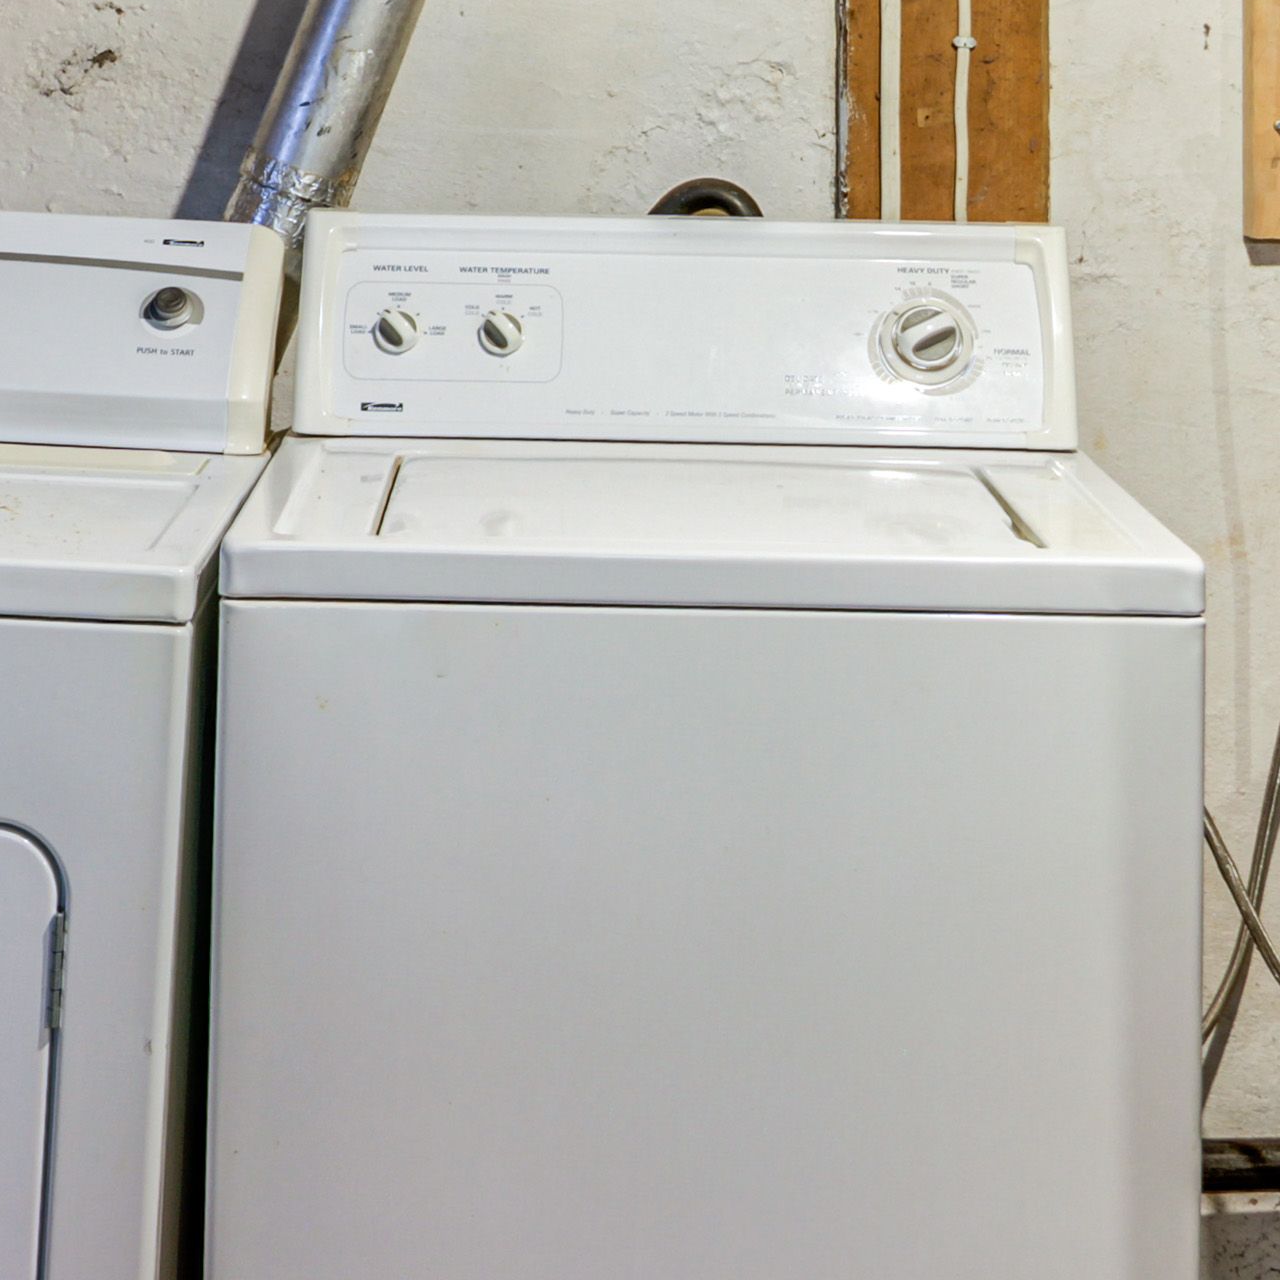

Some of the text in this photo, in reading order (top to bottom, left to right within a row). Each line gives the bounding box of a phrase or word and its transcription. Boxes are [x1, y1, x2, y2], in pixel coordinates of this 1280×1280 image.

[373, 264, 429, 273] WATER LEVEL
[489, 266, 551, 275] TEMPERATURE
[136, 346, 158, 354] PUSH
[171, 348, 196, 357] START
